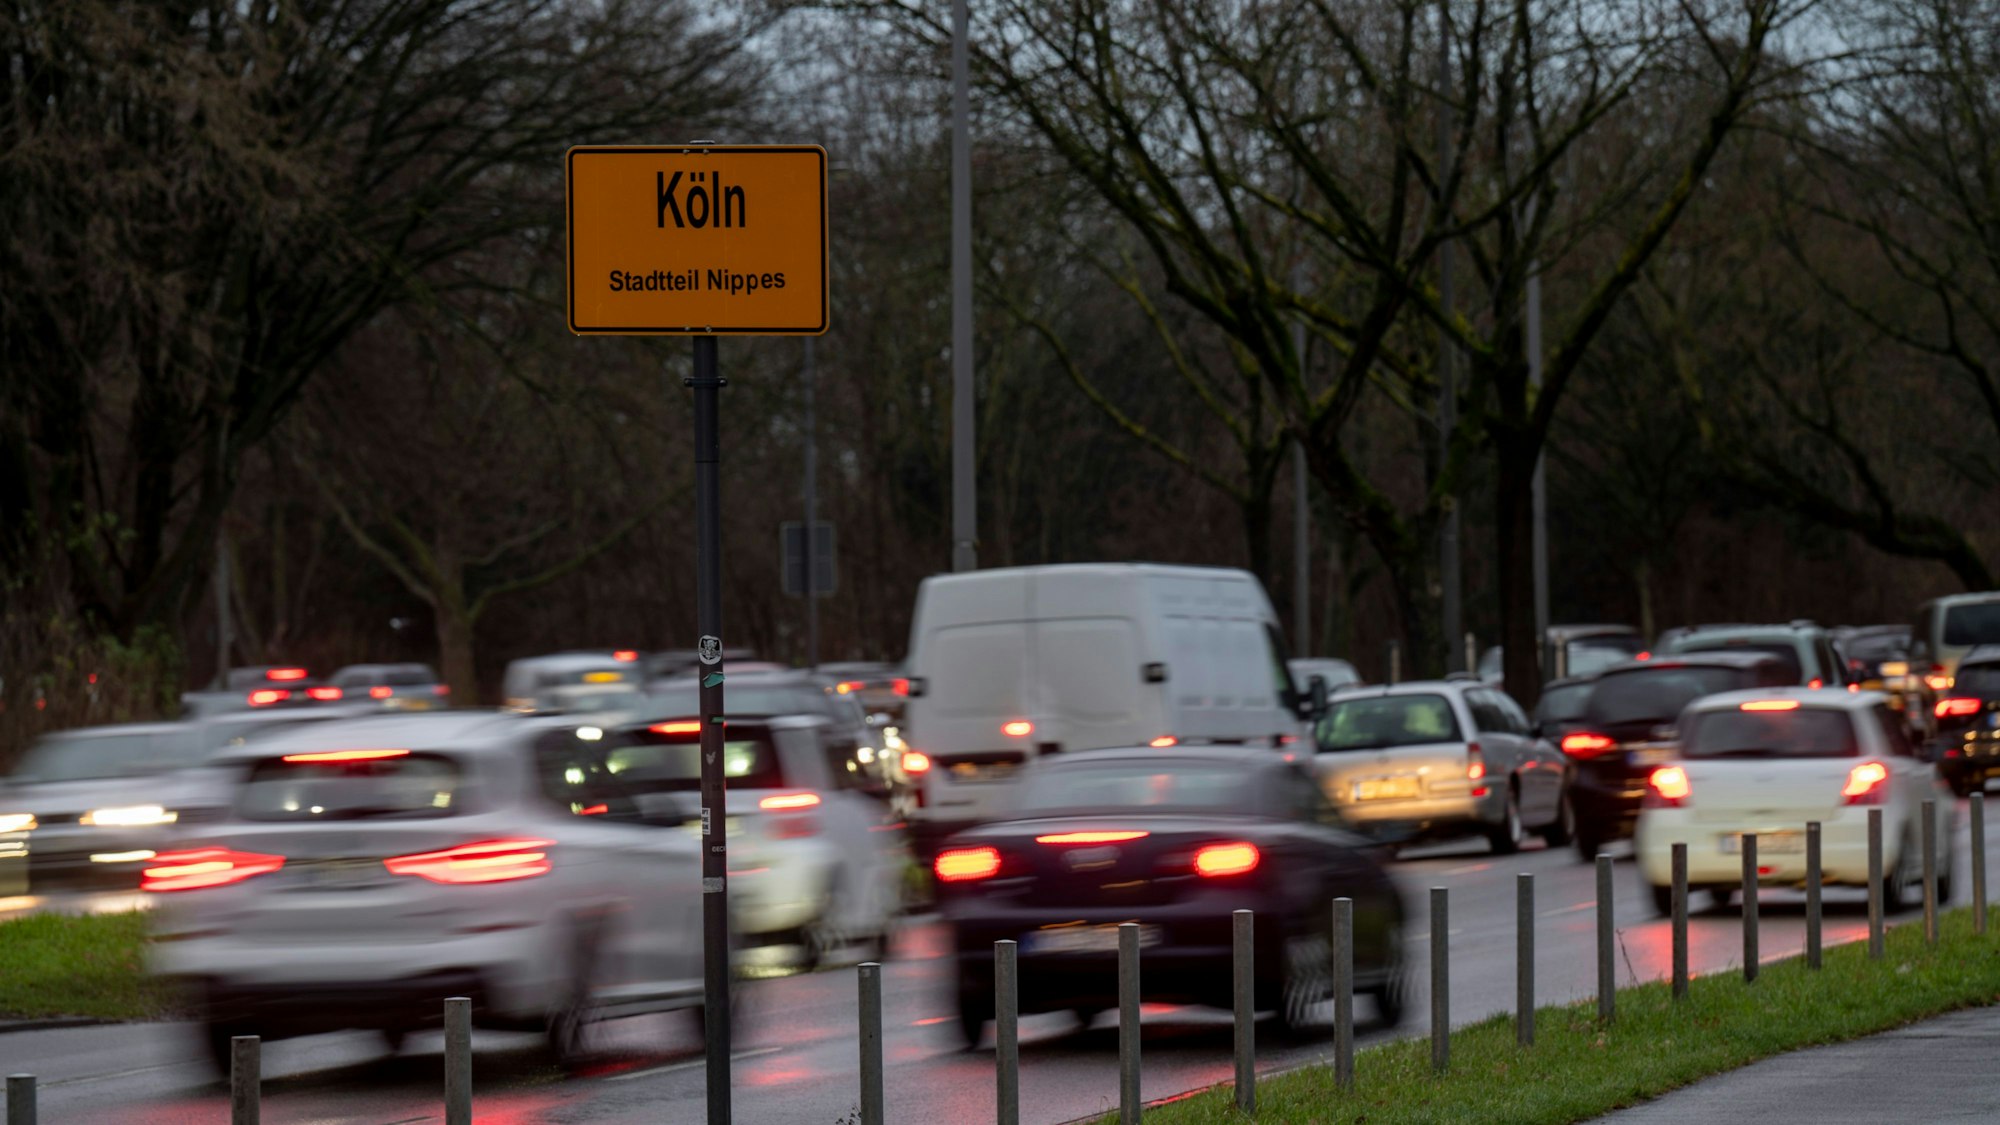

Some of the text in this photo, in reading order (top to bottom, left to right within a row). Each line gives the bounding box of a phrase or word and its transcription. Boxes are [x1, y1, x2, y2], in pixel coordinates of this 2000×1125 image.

[657, 171, 745, 228] Köln
[610, 269, 785, 295] Stadtteil Nippes
